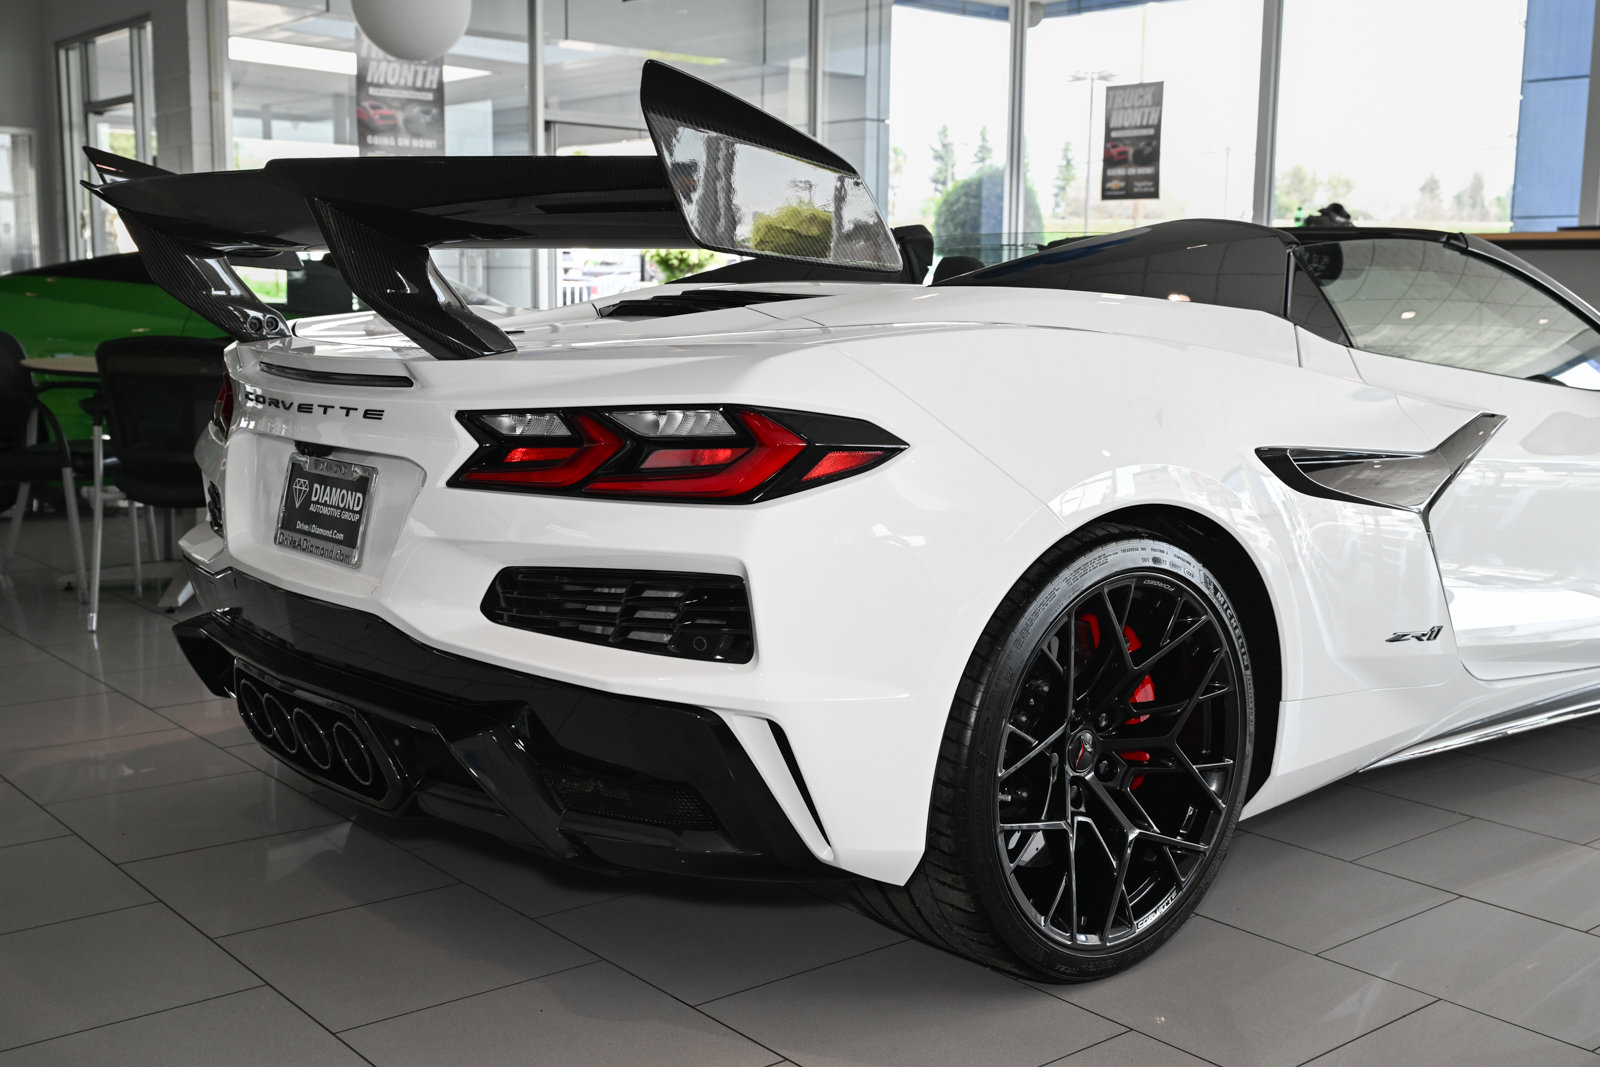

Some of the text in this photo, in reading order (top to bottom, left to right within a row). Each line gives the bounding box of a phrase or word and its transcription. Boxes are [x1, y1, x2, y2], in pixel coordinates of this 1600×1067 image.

[366, 60, 440, 89] MONTH
[1107, 87, 1156, 109] TRUCK
[1109, 105, 1160, 129] MONTH
[245, 391, 385, 420] CORVETTE
[311, 483, 364, 512] DIAMOND
[309, 503, 360, 522] AUTOMOTIVE GROUP
[1143, 578, 1176, 592] FORGED
[1216, 590, 1250, 665] MICHELIN
